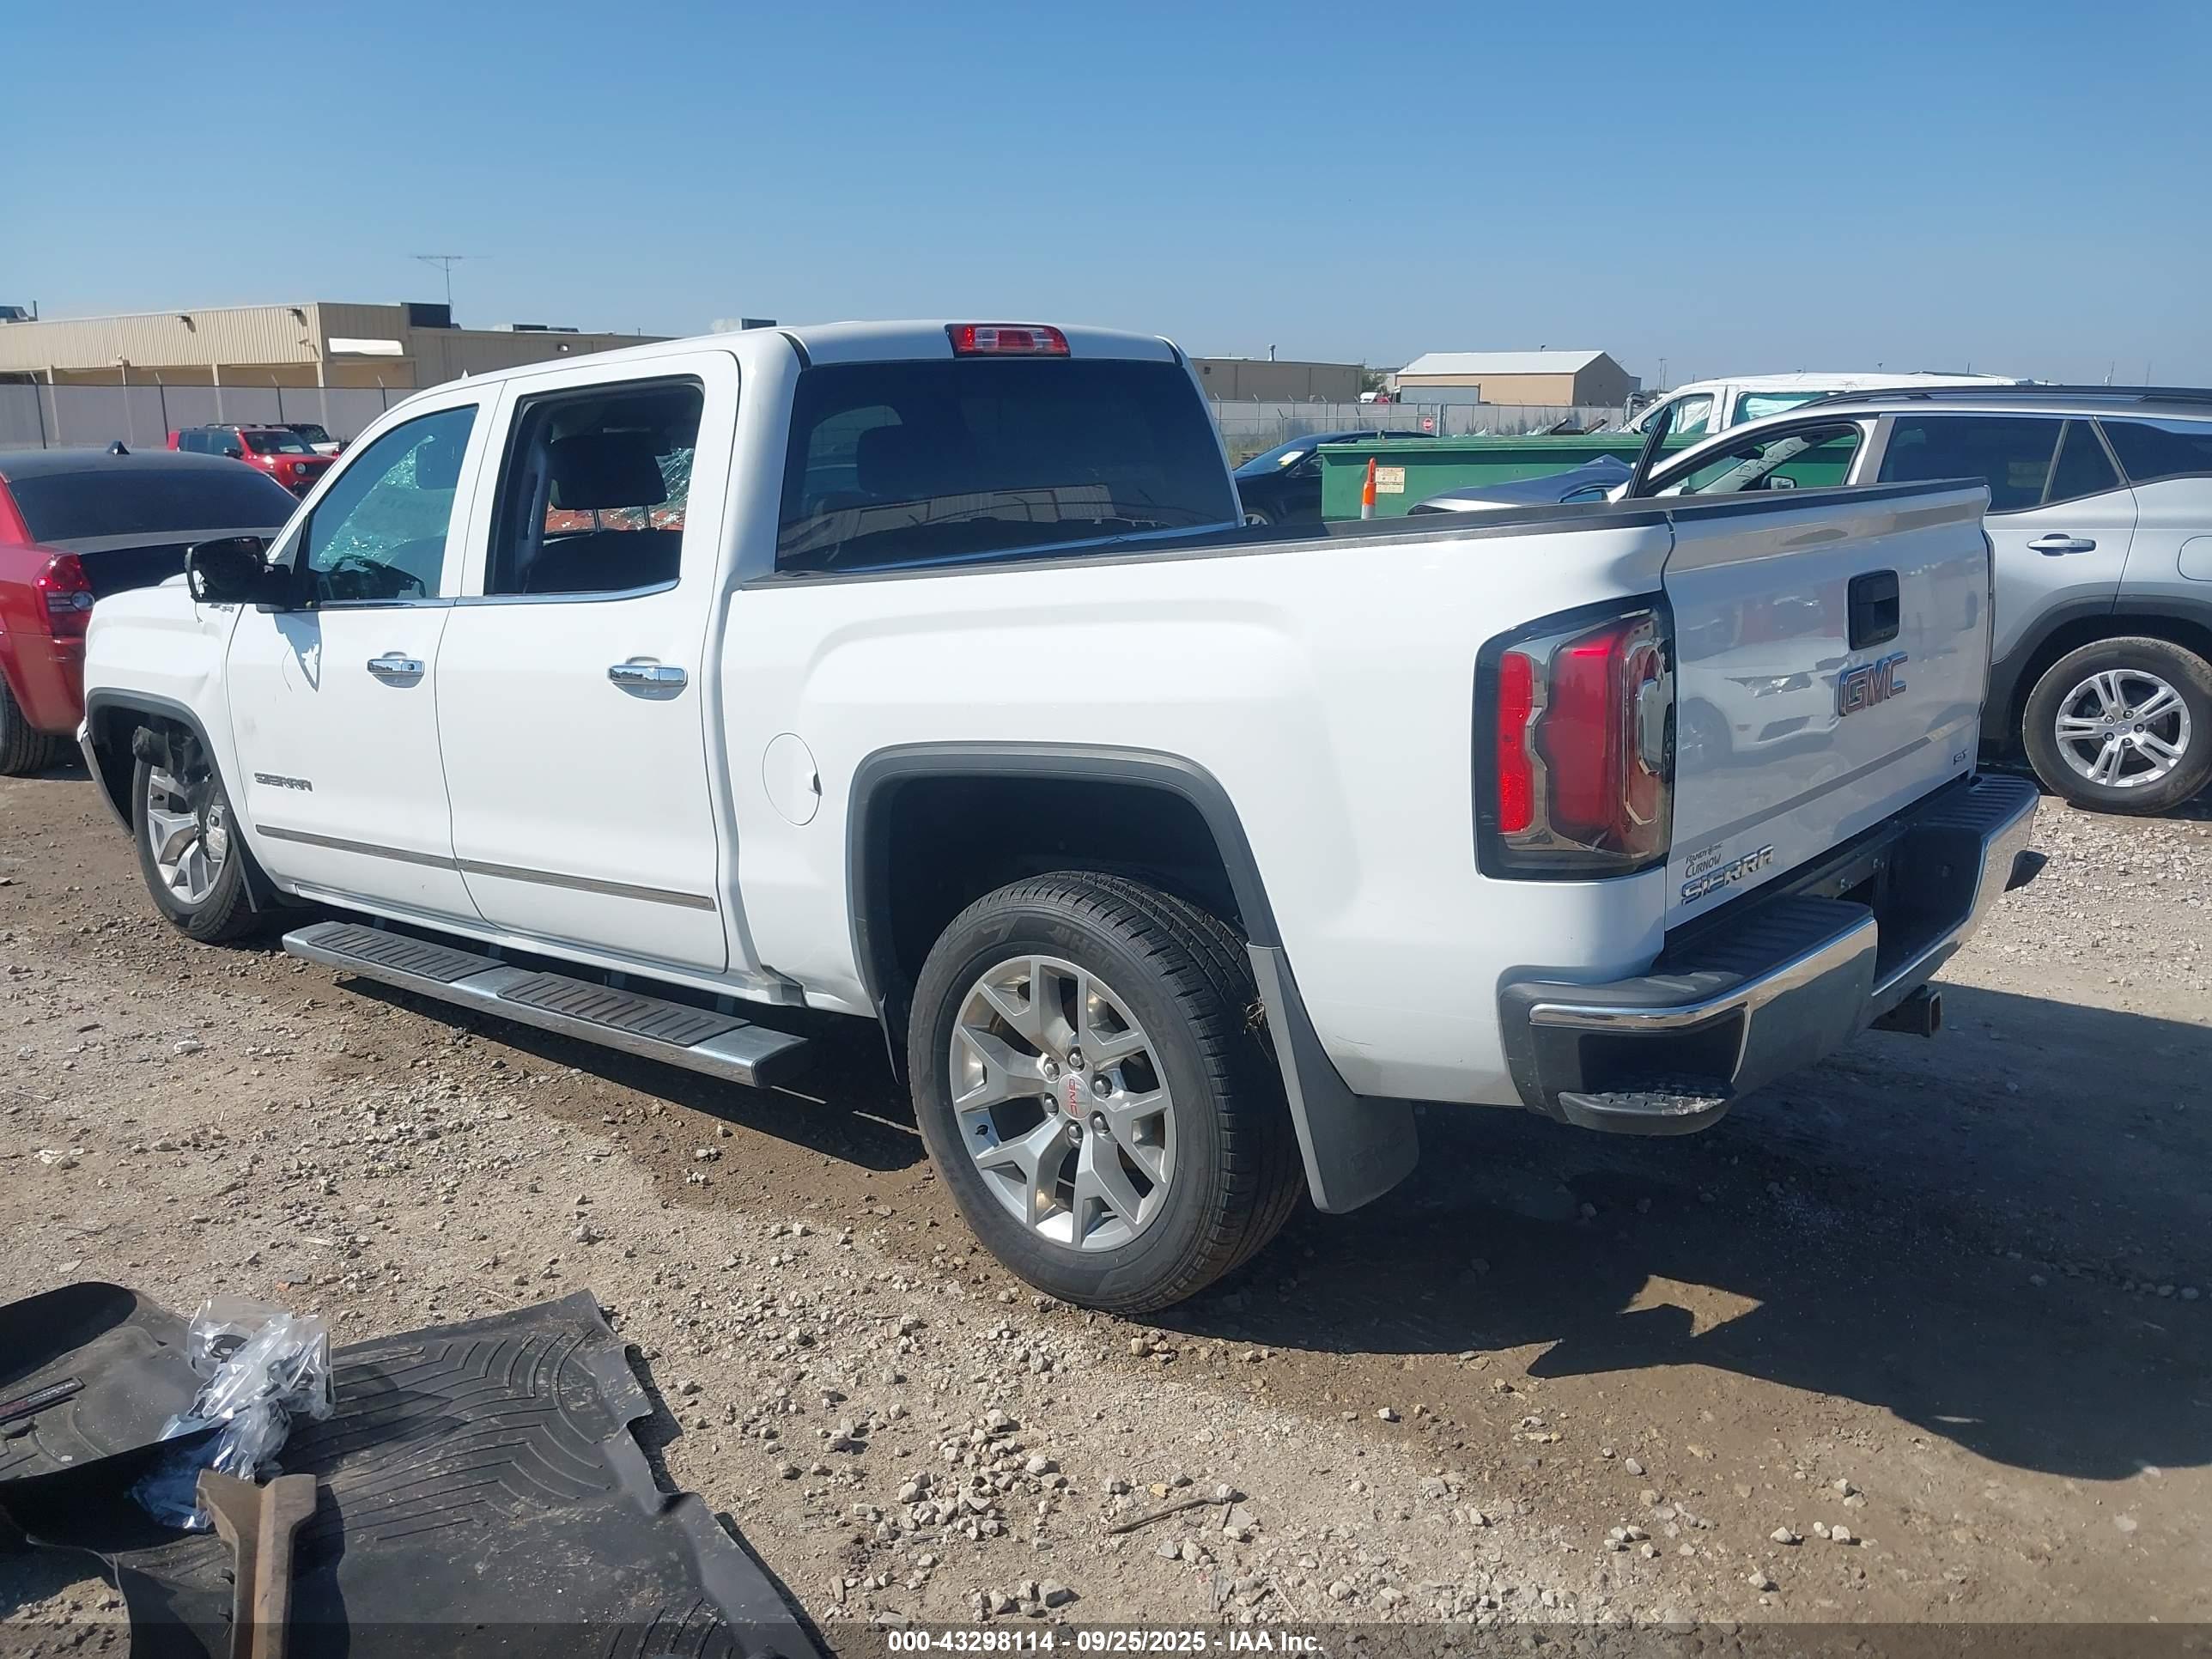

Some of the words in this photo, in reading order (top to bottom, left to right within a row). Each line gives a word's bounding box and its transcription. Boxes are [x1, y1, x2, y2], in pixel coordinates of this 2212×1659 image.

[1838, 651, 1909, 717] GMC
[254, 772, 313, 793] SIERRA
[1681, 843, 1775, 906] SIERRA
[1685, 853, 1722, 879] CURNOW
[1068, 1078, 1079, 1115] GMC
